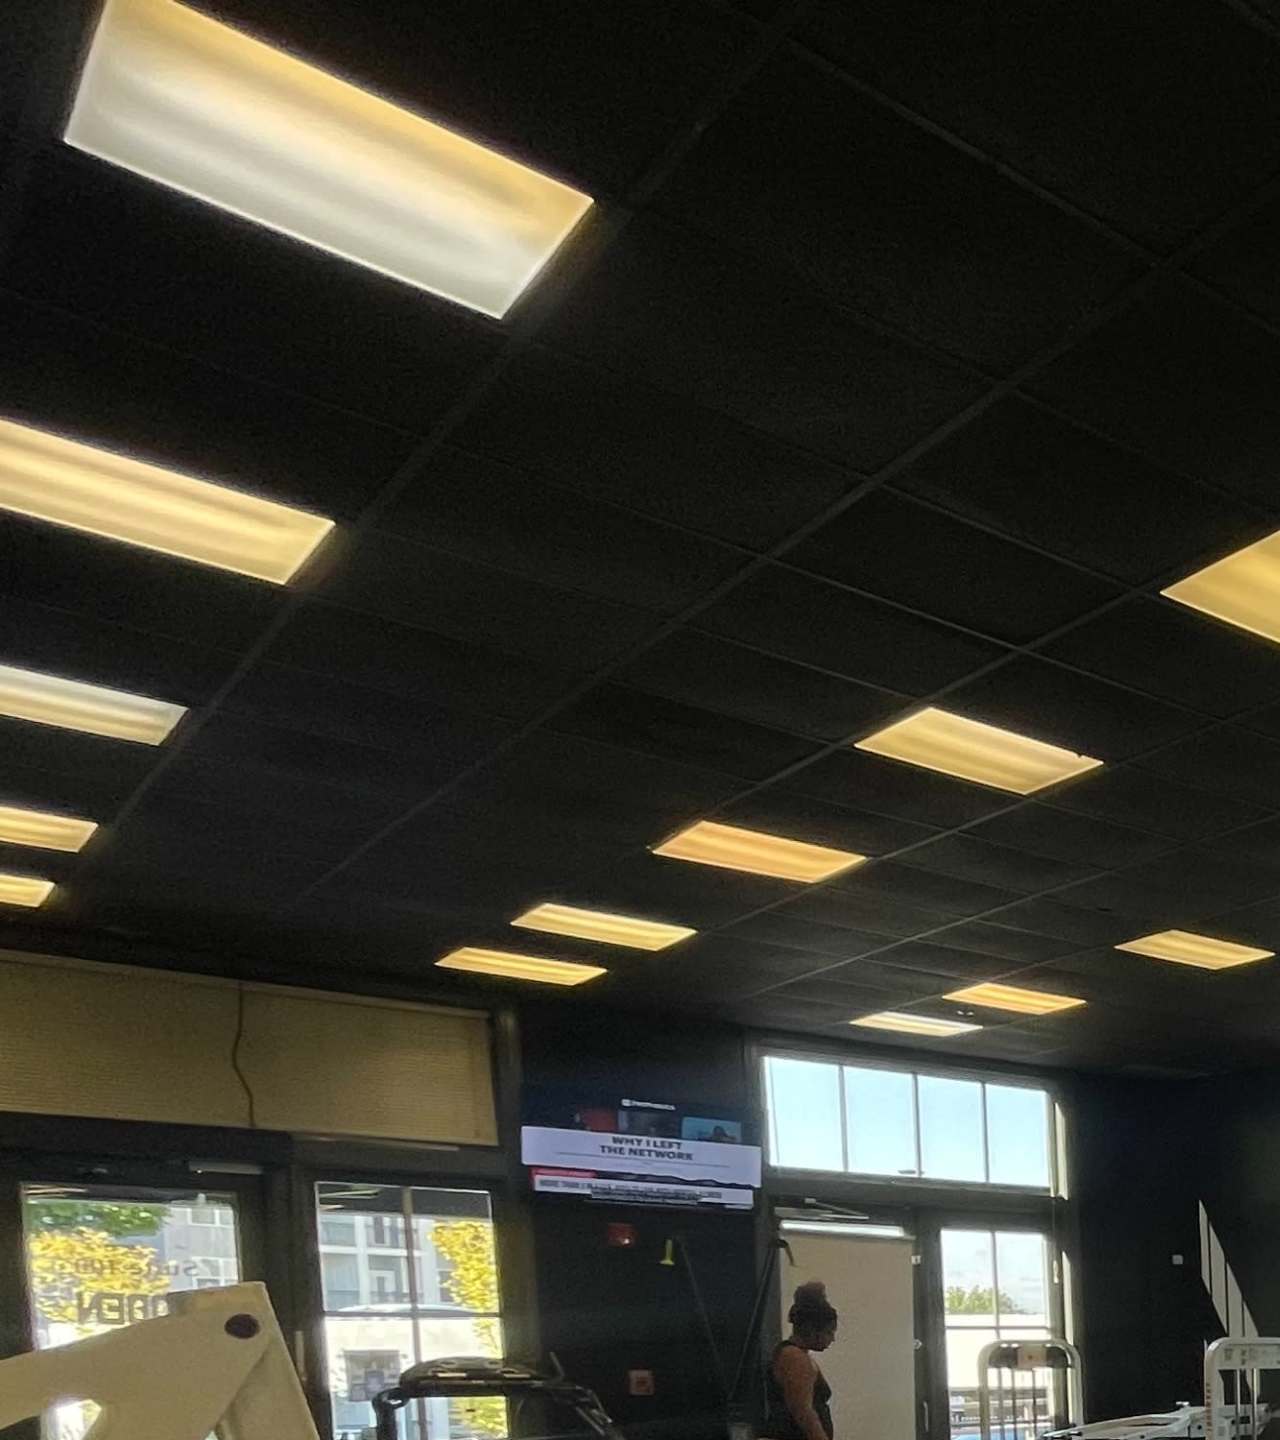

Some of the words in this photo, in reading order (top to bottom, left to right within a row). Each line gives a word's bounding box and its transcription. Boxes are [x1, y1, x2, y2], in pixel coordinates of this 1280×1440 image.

[612, 1136, 643, 1147] WHY
[652, 1140, 682, 1149] LEFT
[600, 1145, 626, 1156] THE
[628, 1147, 693, 1161] NETWORK
